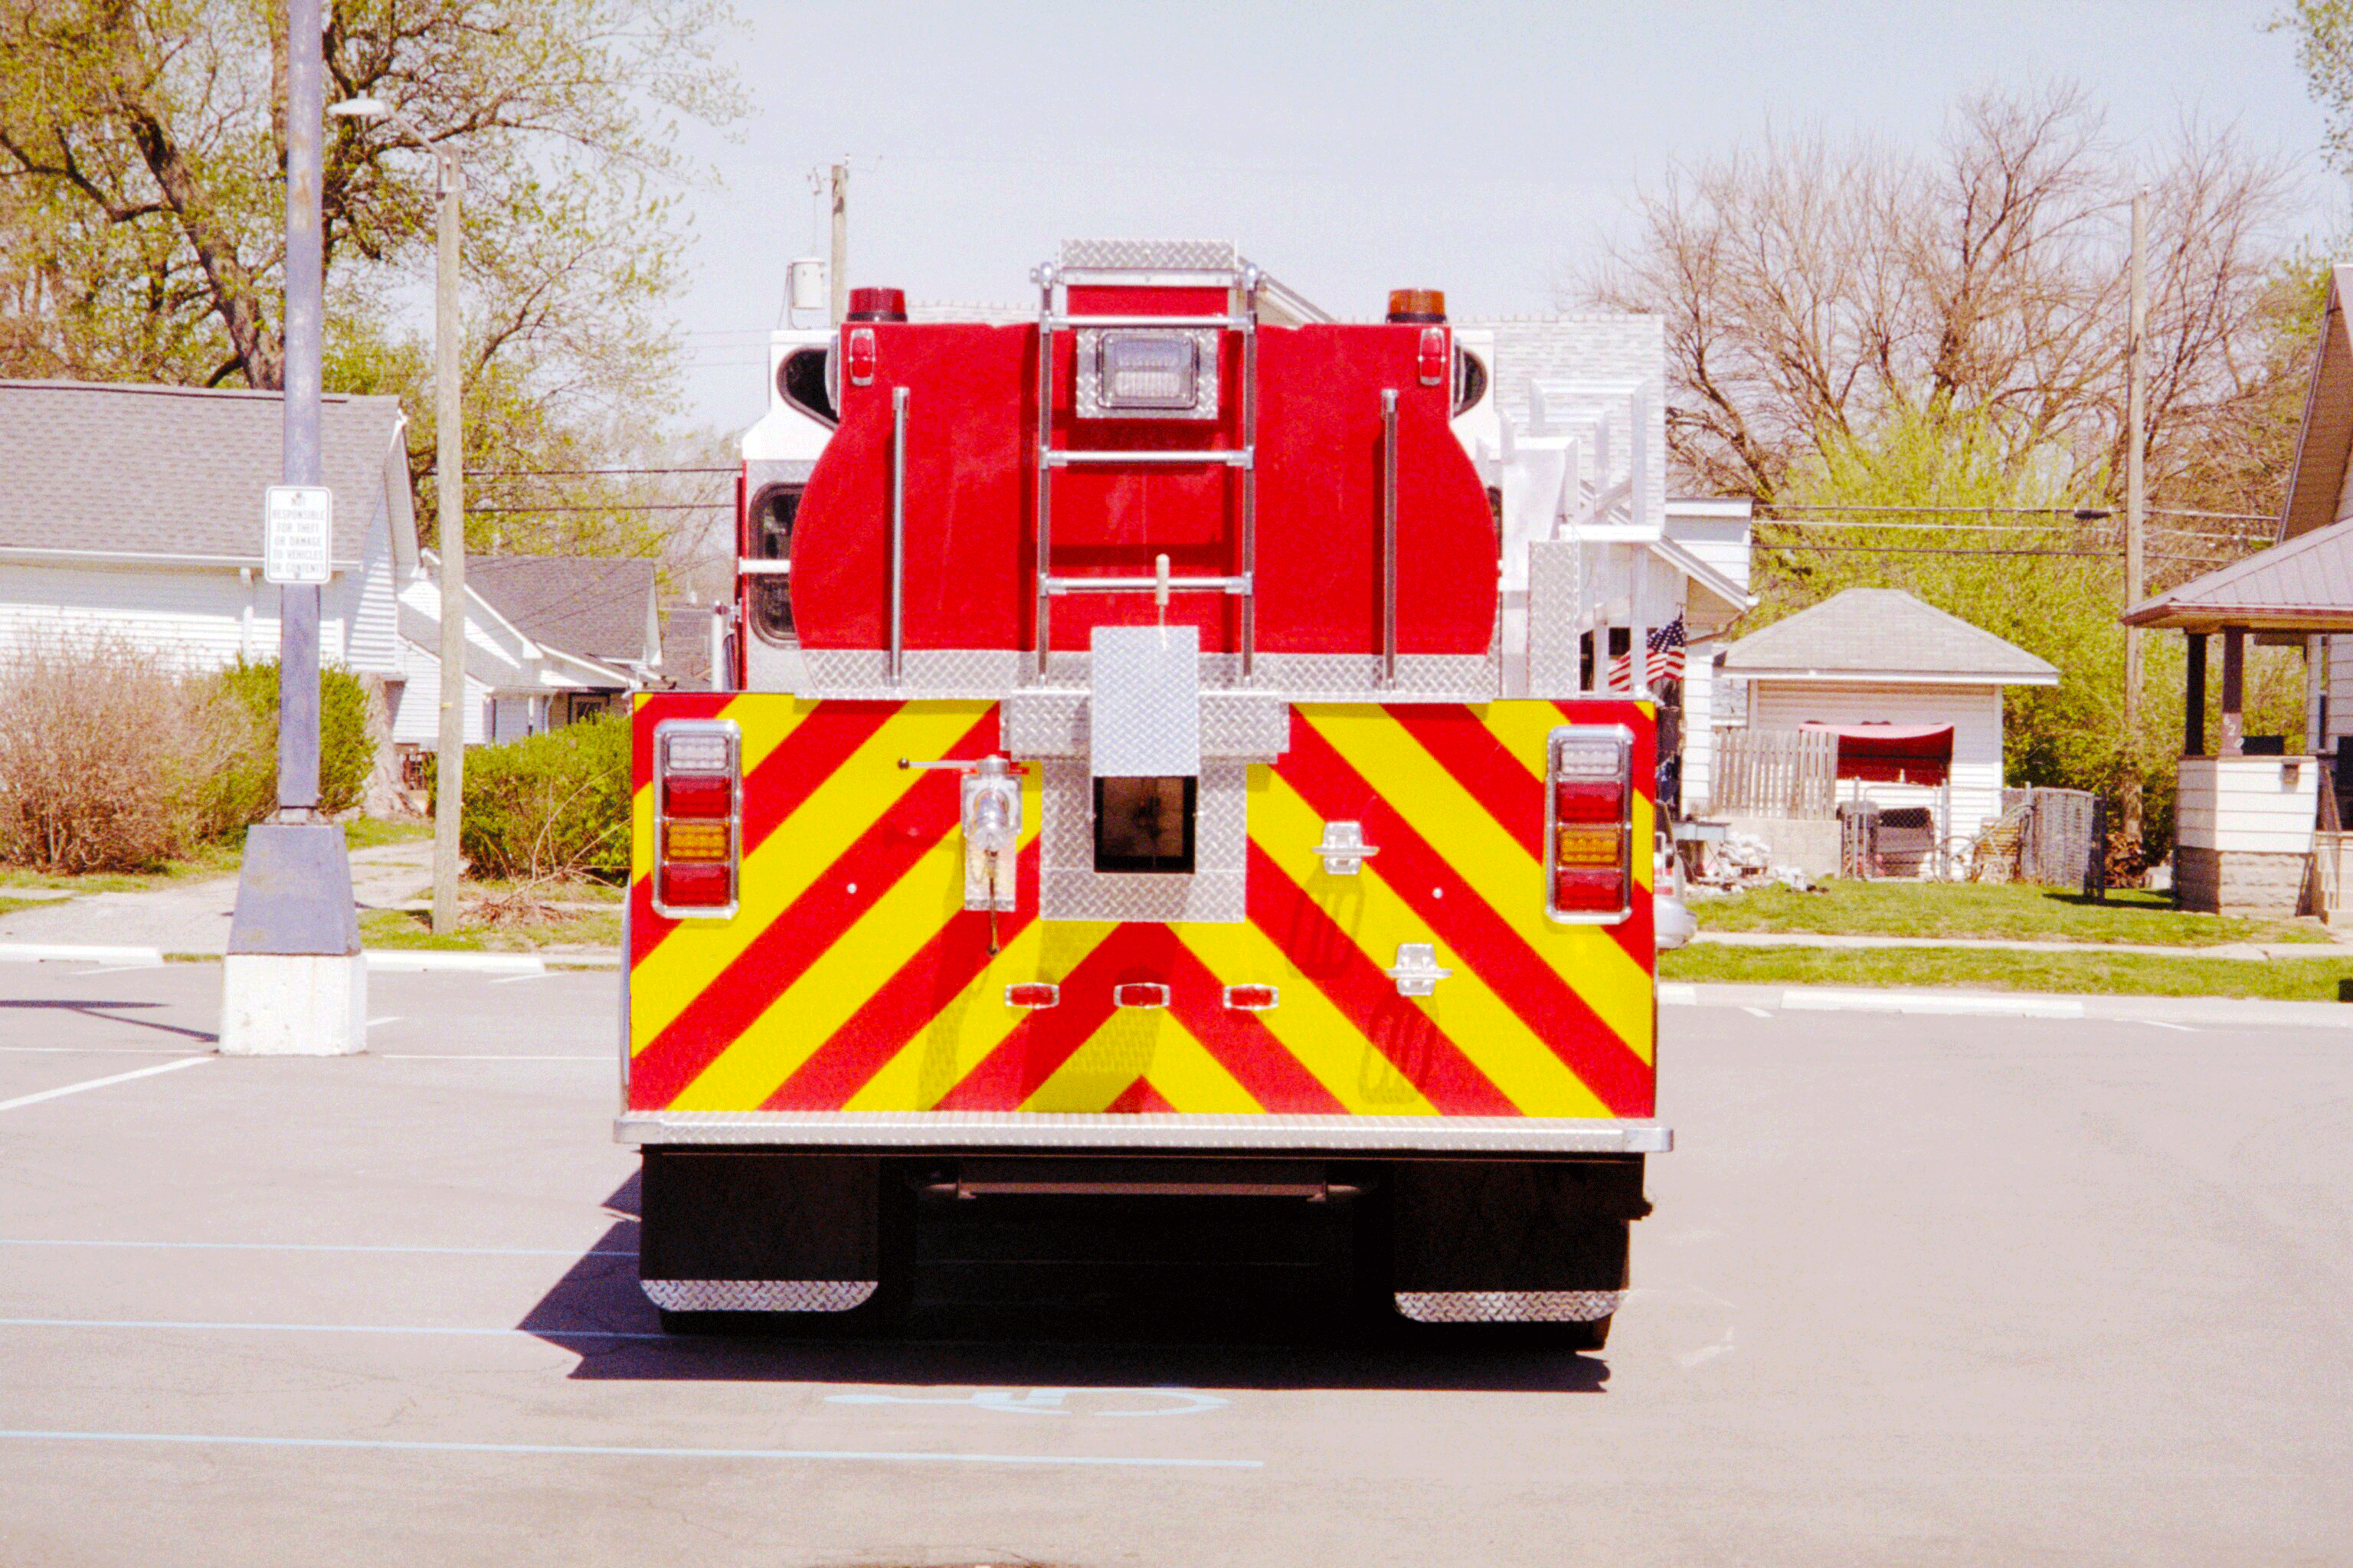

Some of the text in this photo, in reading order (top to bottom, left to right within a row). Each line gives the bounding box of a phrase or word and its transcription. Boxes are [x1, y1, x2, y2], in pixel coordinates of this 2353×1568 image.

[272, 509, 325, 520] RESPONSIBLE
[277, 522, 319, 533] FOR THEFT
[274, 535, 321, 547] OR DAMAGE
[273, 549, 323, 560] TO VEHICLES
[270, 562, 325, 573] OR CONTENTS
